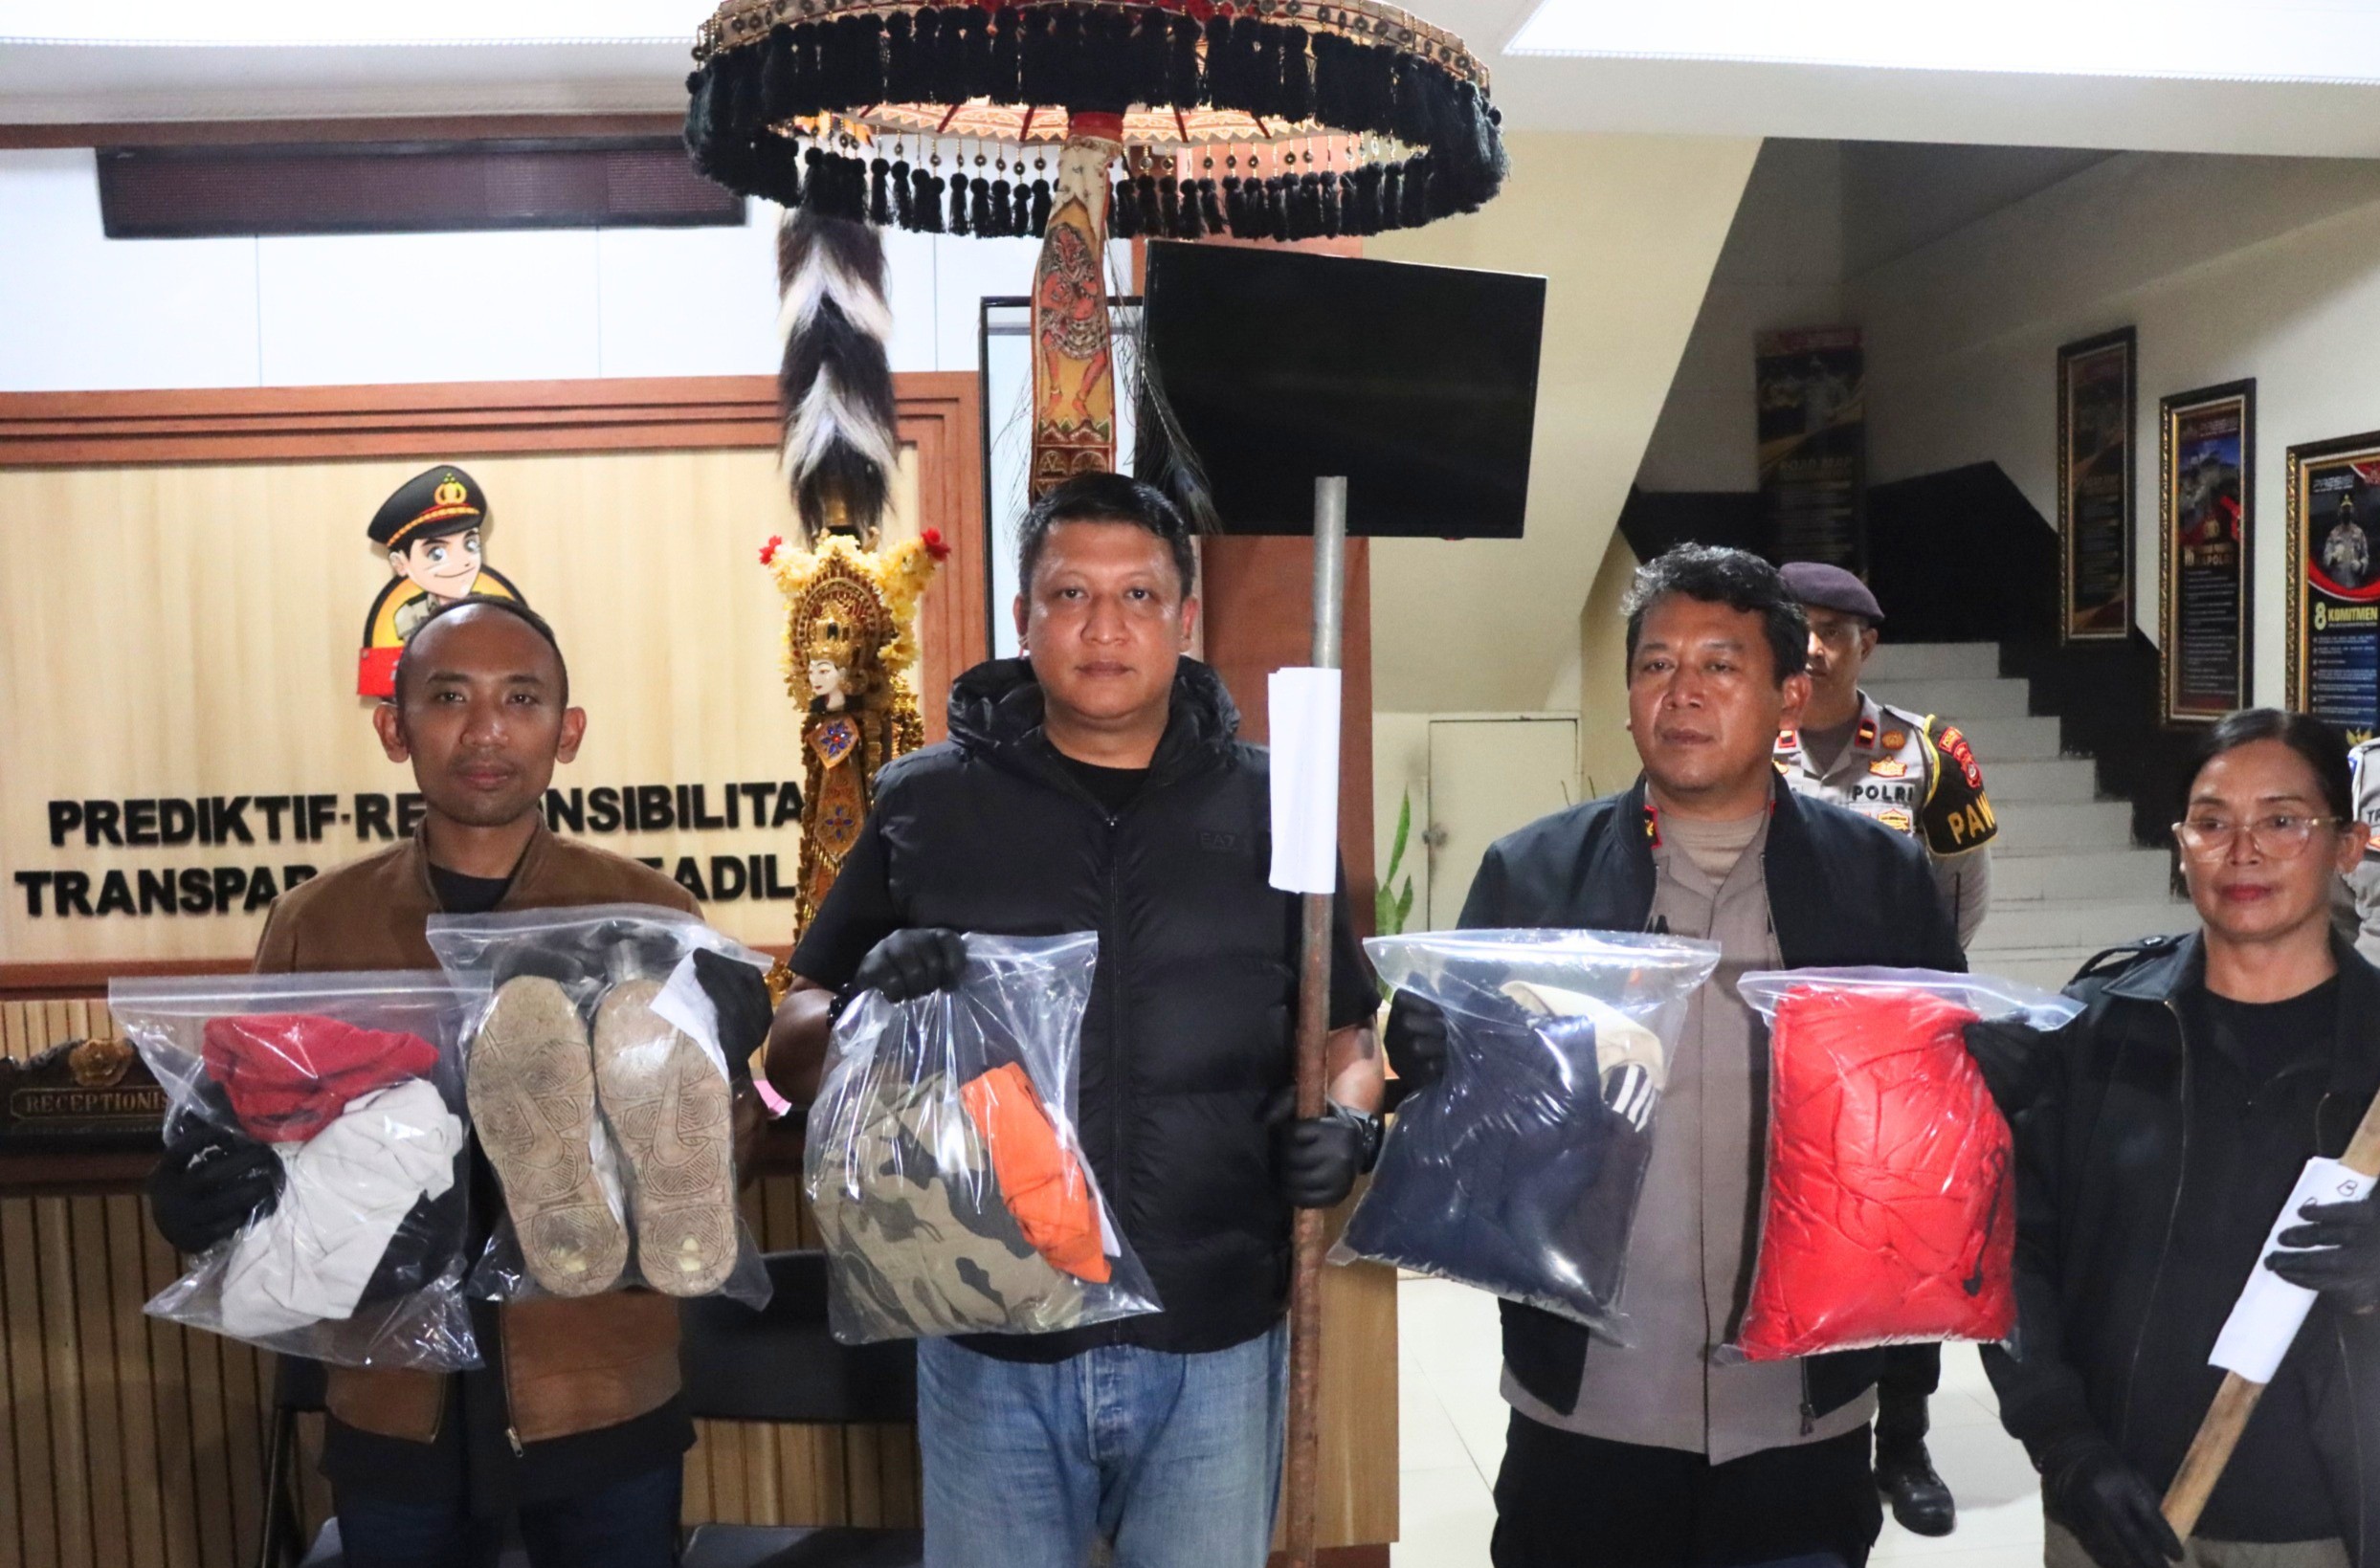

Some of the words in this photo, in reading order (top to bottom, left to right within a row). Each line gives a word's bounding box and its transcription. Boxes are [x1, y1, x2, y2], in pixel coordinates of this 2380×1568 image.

[2315, 602, 2326, 630] 8
[2327, 607, 2378, 622] KOMITMEN
[1852, 784, 1913, 802] POLRI
[49, 782, 805, 847] PREDIKTIF-RENSIBILITA
[1200, 832, 1235, 848] EA7
[26, 1092, 170, 1113] RECEPTIONIS
